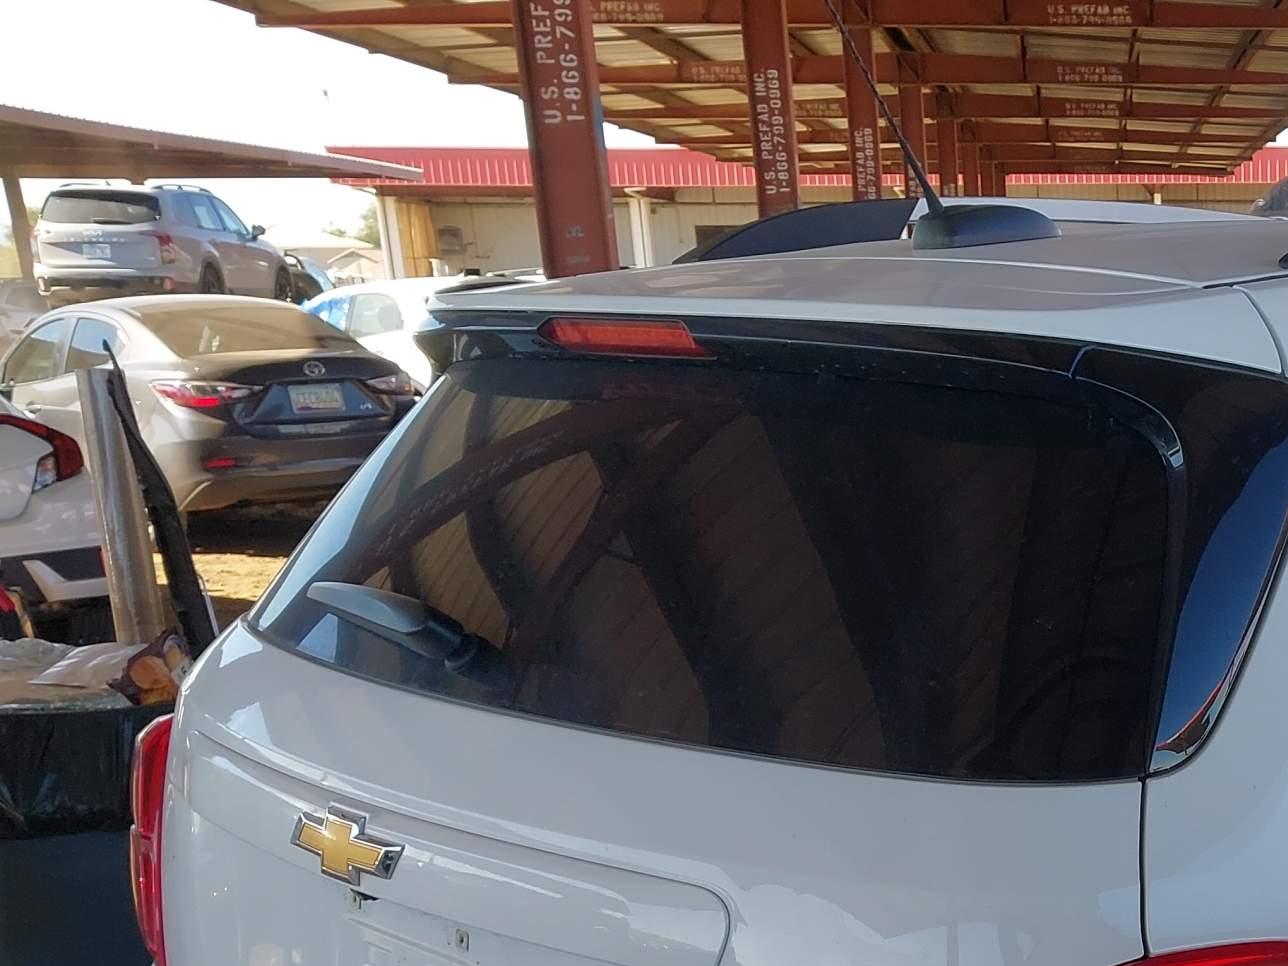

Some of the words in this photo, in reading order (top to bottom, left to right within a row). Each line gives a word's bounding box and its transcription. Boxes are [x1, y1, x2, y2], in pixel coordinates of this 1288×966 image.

[530, 2, 556, 64] PREF
[541, 79, 562, 123] U.S.
[756, 104, 774, 160] PREFAB
[764, 167, 777, 194] U.S.
